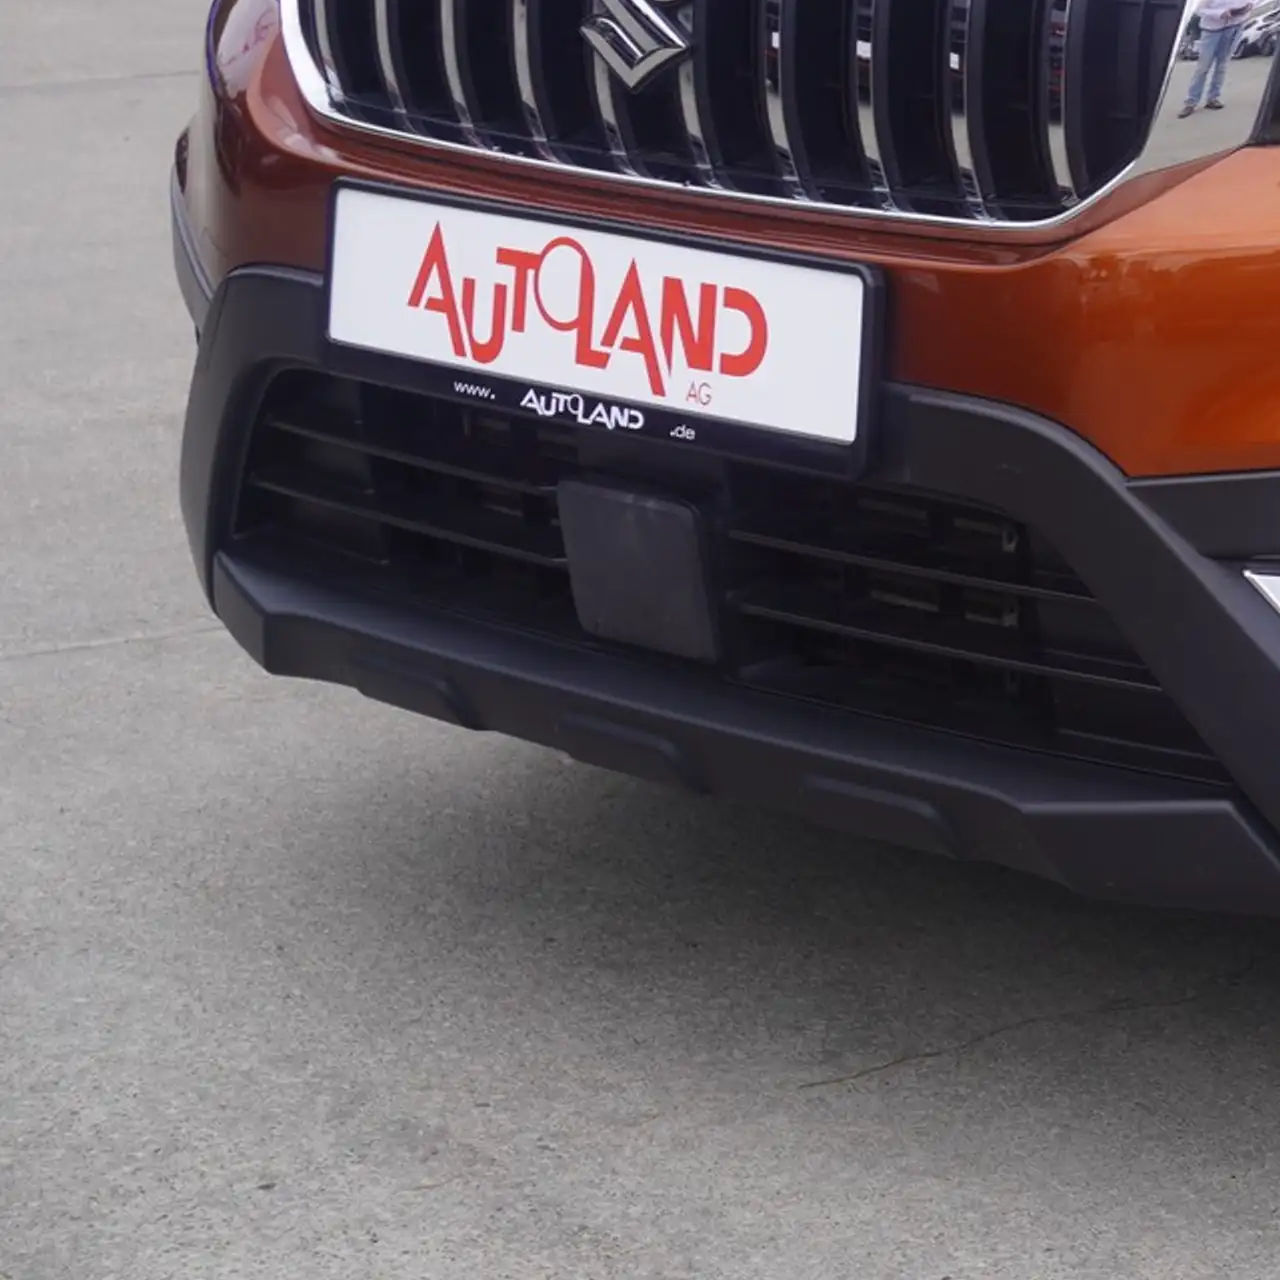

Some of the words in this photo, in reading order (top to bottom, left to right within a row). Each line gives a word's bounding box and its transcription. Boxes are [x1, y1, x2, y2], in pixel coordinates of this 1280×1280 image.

[407, 220, 769, 397] AUTOLAND
[453, 380, 496, 401] www.
[519, 388, 645, 430] AUTOLAND
[669, 424, 697, 441] .de
[685, 382, 713, 406] AG
